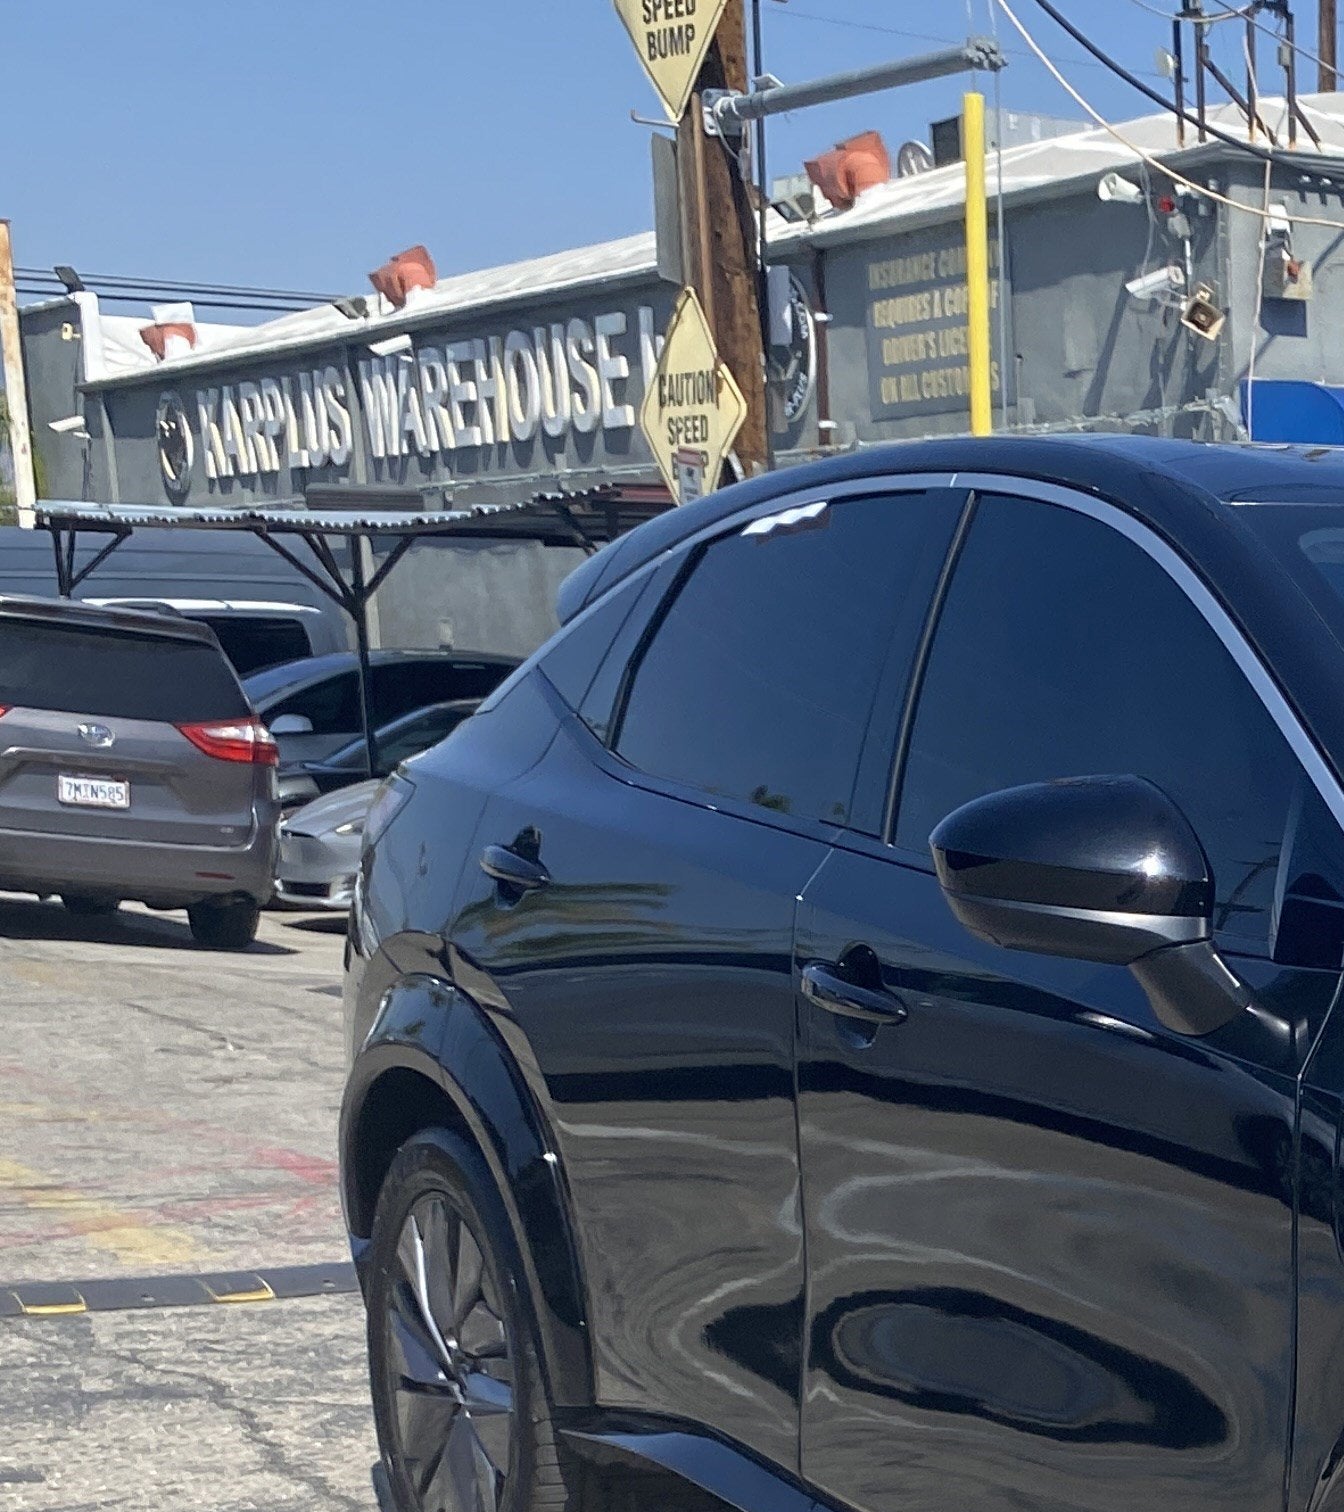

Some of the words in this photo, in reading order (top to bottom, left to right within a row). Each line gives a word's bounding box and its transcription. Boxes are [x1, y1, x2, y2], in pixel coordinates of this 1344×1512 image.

[642, 0, 696, 24] SPEED
[646, 23, 696, 61] BUMP
[196, 366, 353, 479] KARPLUS
[358, 312, 636, 458] WAREHOUSE
[659, 370, 715, 407] CAUTION
[667, 414, 709, 445] SPEED
